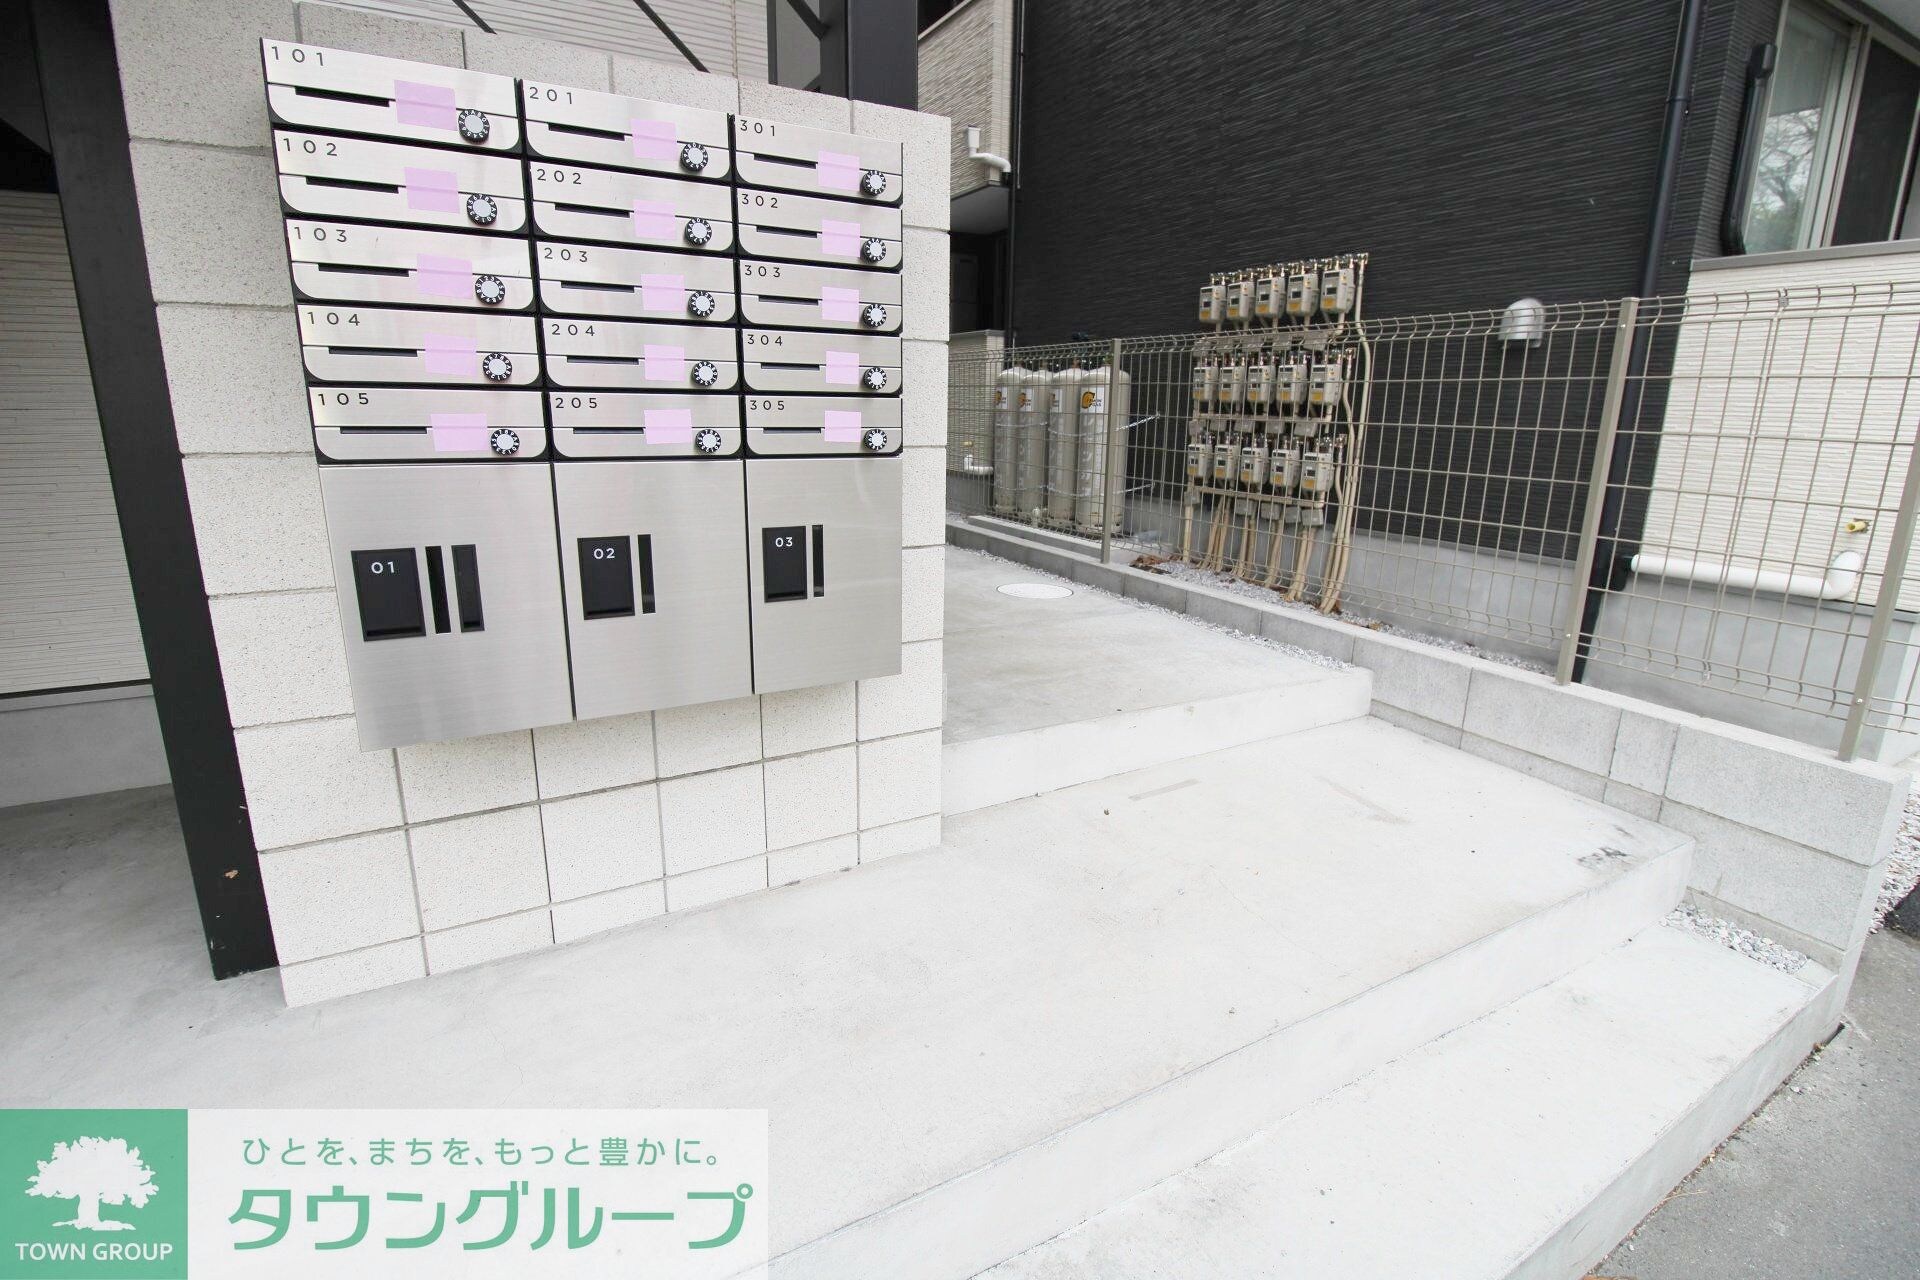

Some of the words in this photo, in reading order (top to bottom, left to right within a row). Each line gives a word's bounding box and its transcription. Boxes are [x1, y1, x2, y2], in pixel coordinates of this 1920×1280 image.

[271, 44, 327, 67] 101
[530, 87, 573, 104] 201
[740, 120, 775, 136] 301
[283, 135, 340, 156] 102
[537, 166, 584, 184] 202
[742, 191, 781, 208] 302
[294, 224, 350, 242] 103
[544, 245, 590, 262] 203
[745, 262, 784, 277] 303
[308, 312, 360, 326] 104
[552, 324, 595, 336] 204
[748, 334, 782, 346] 304
[318, 393, 368, 405] 105
[555, 398, 597, 408] 205
[750, 400, 784, 410] 305
[775, 537, 792, 548] 03
[593, 547, 615, 559] 02
[371, 562, 394, 574] 01
